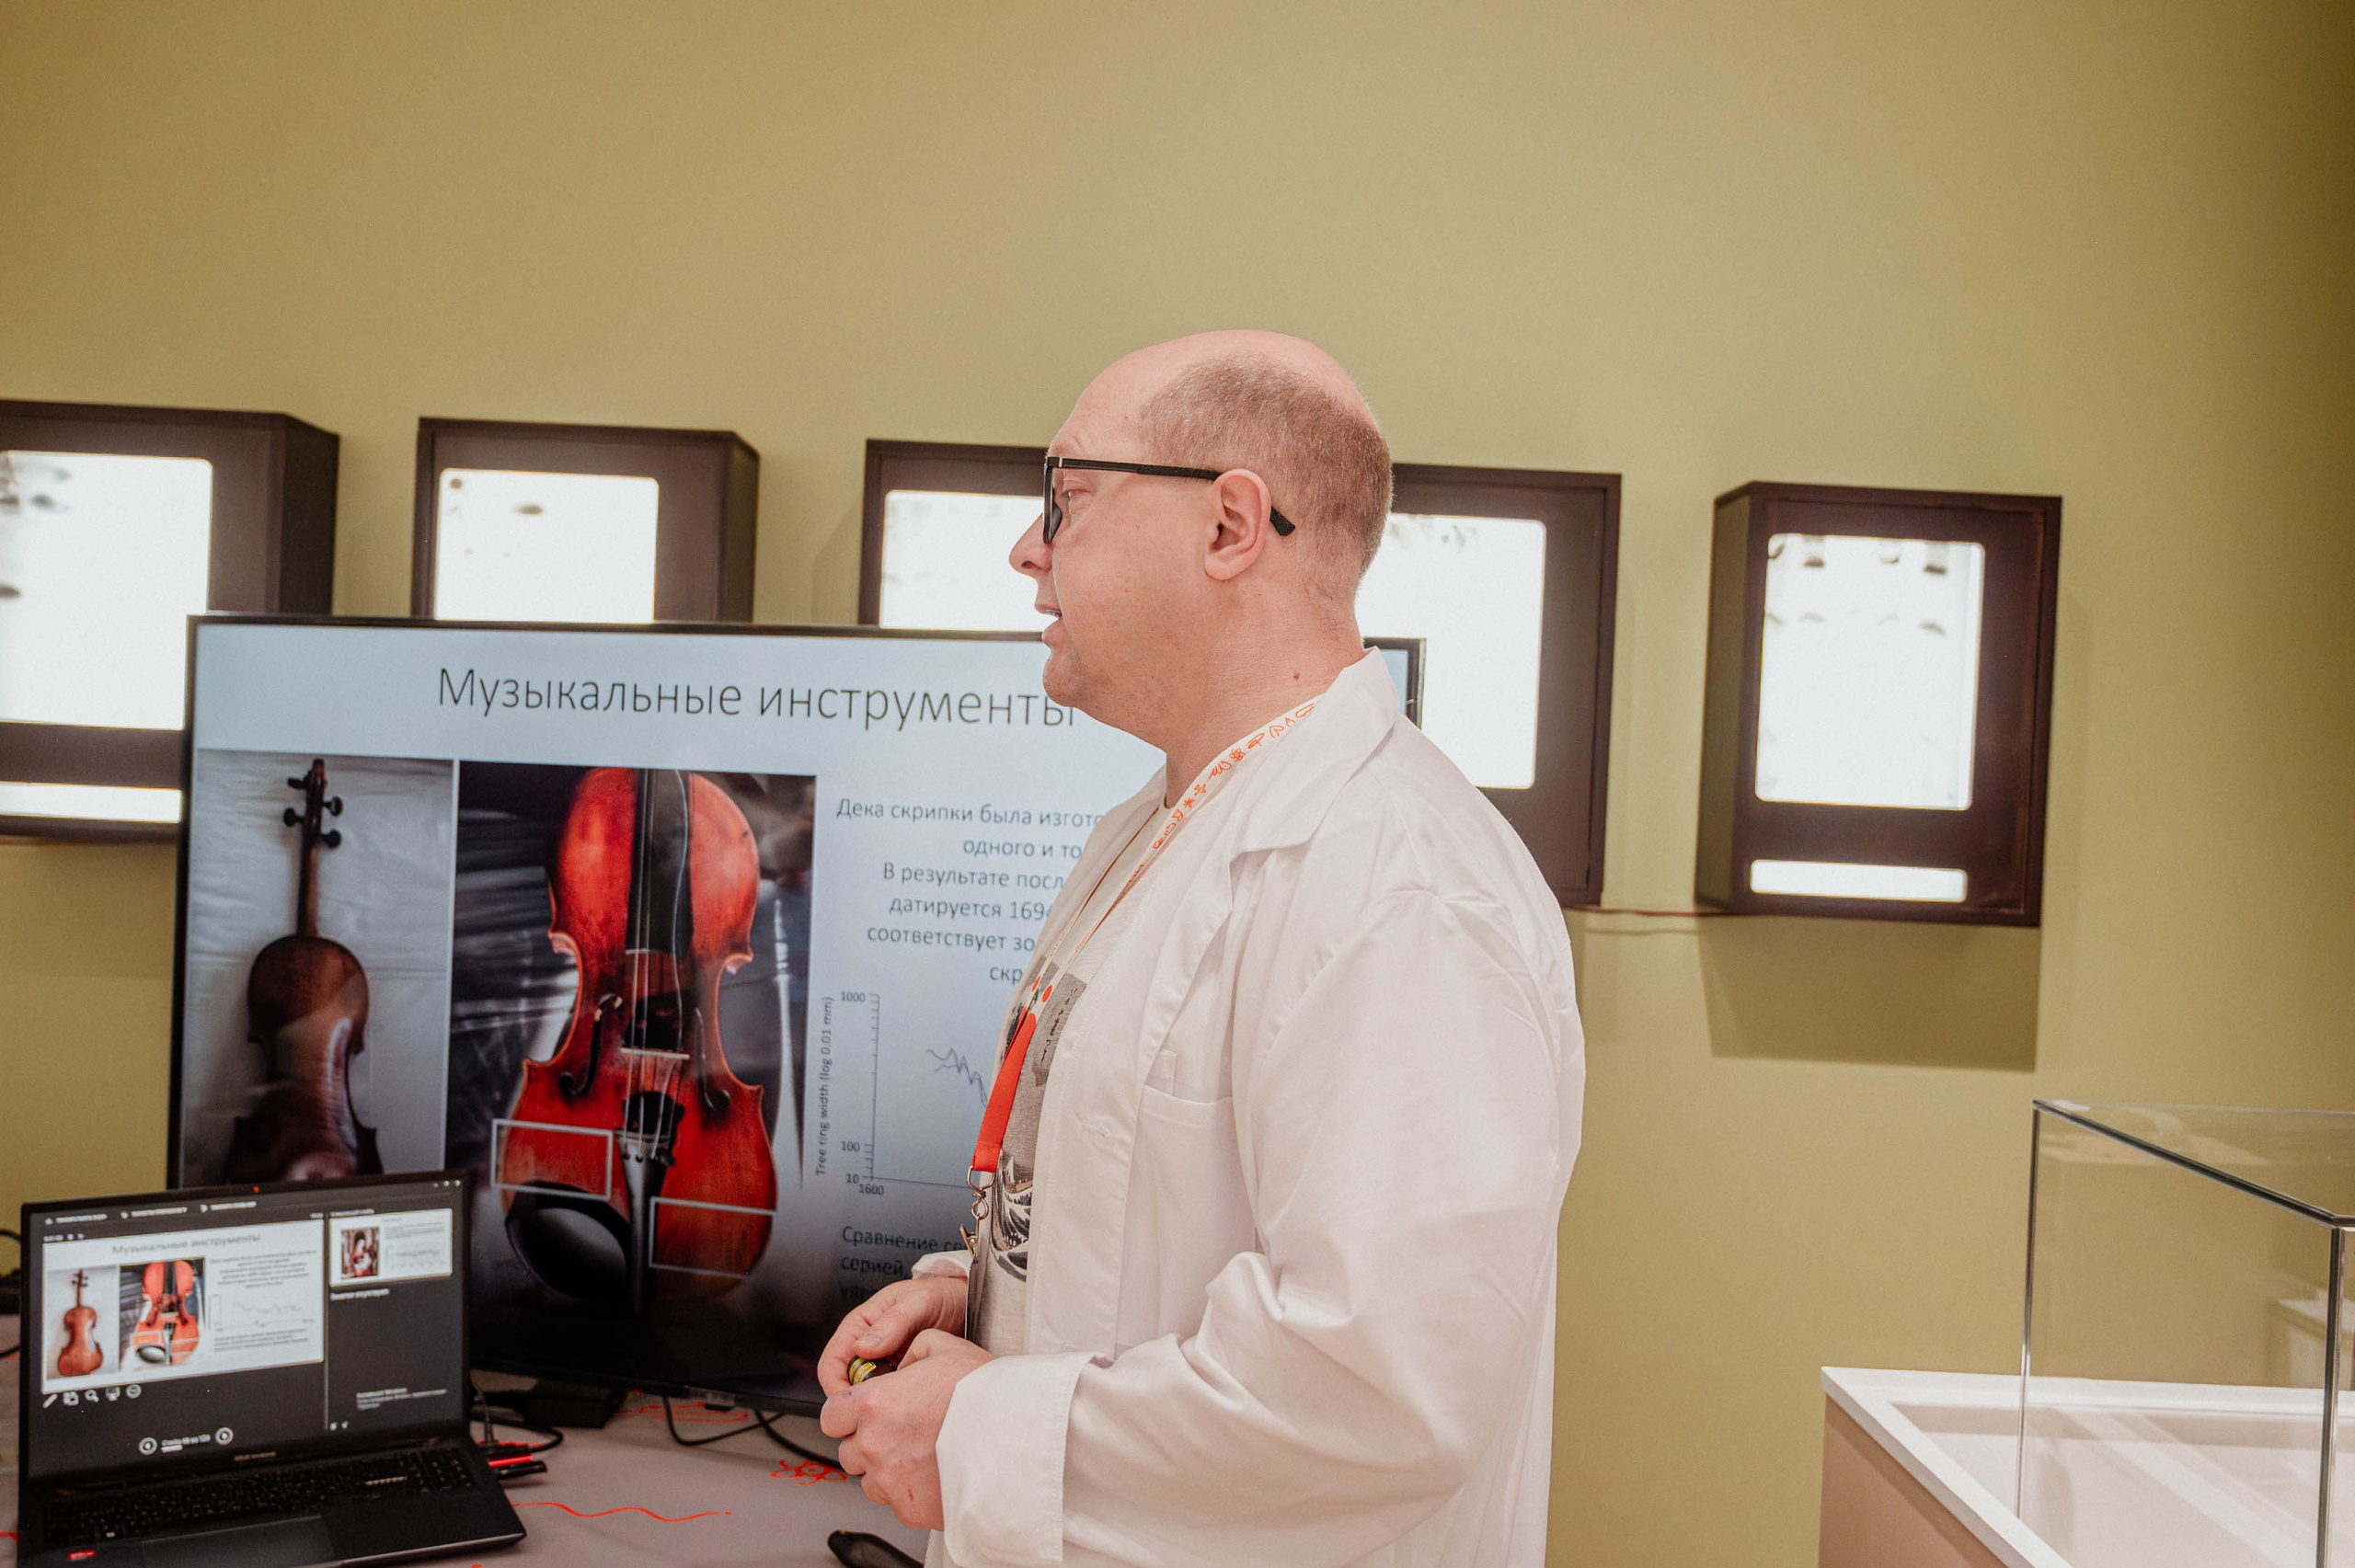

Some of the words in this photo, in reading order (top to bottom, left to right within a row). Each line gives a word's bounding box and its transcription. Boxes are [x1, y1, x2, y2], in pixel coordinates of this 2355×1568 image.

[438, 667, 741, 716] Музыкальные
[760, 685, 1074, 730] инструменты
[836, 798, 884, 818] Дека
[890, 804, 972, 822] скрипки
[980, 804, 1032, 825] была
[963, 839, 1035, 856] одного
[1042, 844, 1053, 856] и
[883, 862, 895, 879] В
[902, 868, 1010, 887] результате
[889, 898, 1001, 918] датируется
[867, 926, 1006, 950] соответствует
[841, 992, 866, 1002] 1000
[824, 996, 835, 1025] mm)
[821, 1029, 832, 1055] 0.01
[820, 1058, 833, 1082] (log
[819, 1083, 830, 1118] width
[819, 1120, 830, 1146] ring
[841, 1140, 860, 1151] 100
[815, 1148, 827, 1175] Tree
[846, 1173, 859, 1184] 10
[858, 1184, 884, 1196] 1600
[842, 1225, 938, 1252] Сравнение
